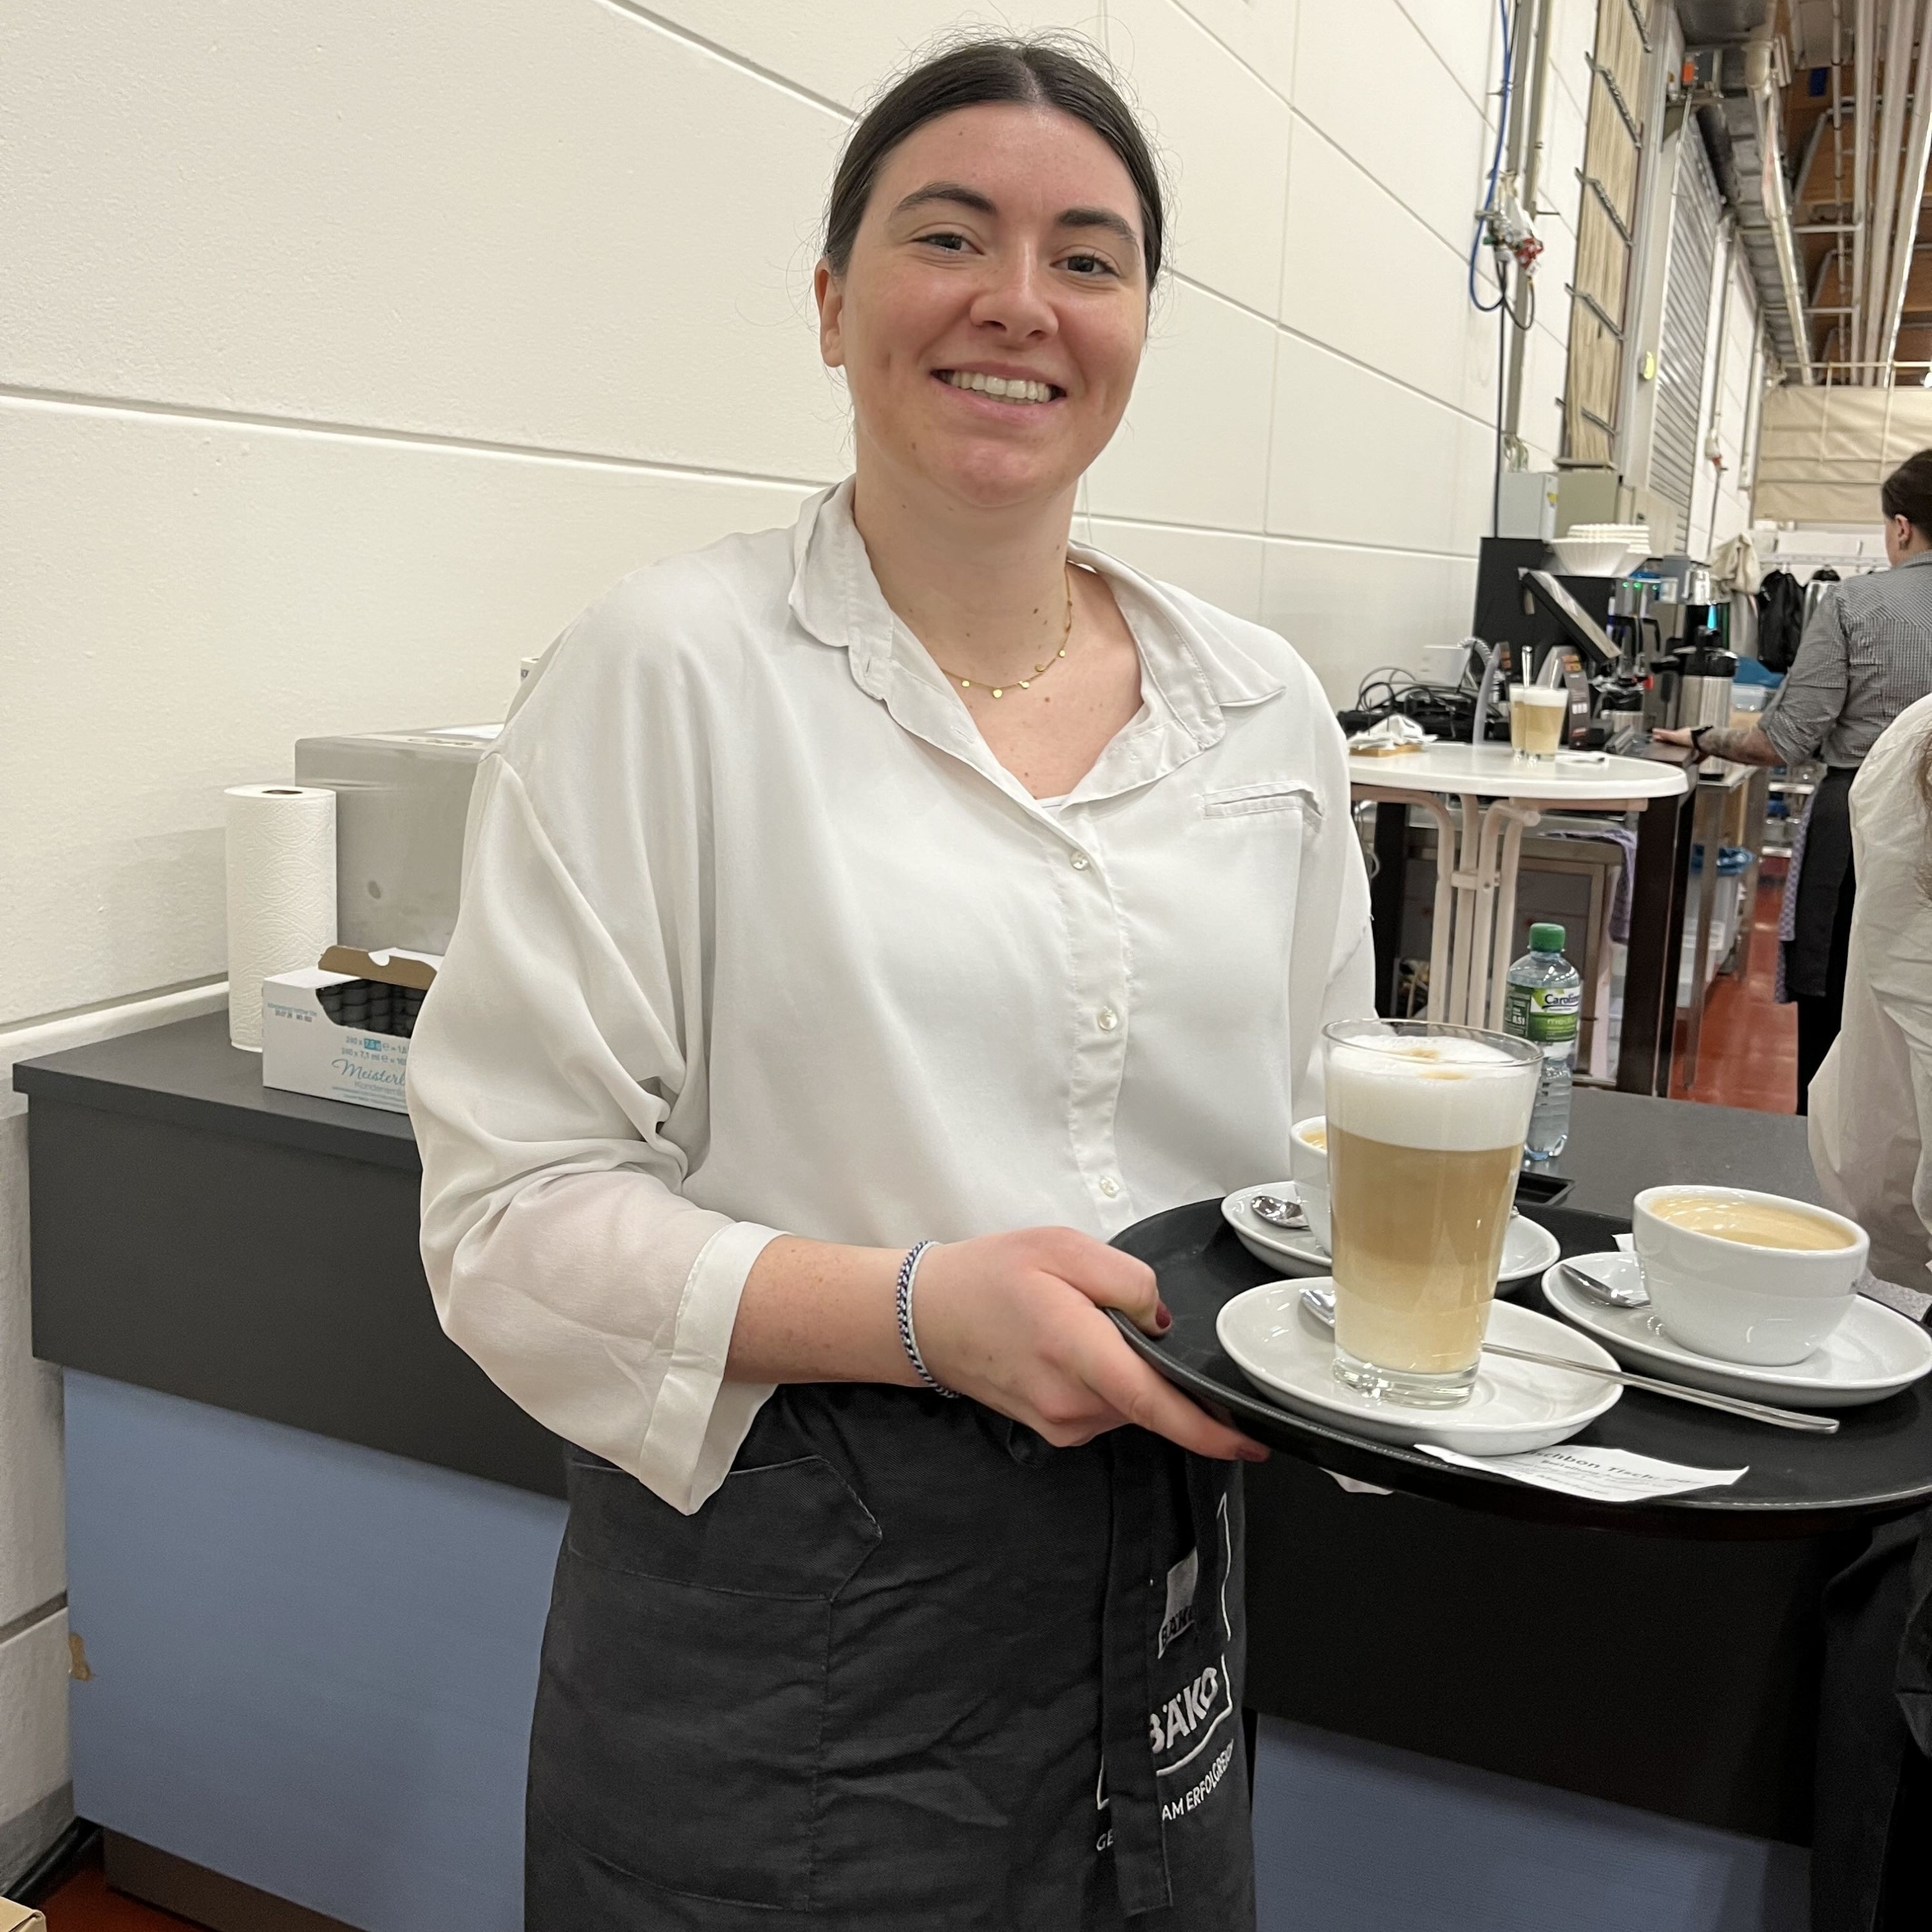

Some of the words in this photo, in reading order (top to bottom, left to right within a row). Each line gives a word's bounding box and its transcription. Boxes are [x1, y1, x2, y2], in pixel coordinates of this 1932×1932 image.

[1150, 1667, 1218, 1754] BÄKO
[1096, 1828, 1114, 1852] GE
[1161, 1797, 1184, 1821] AM
